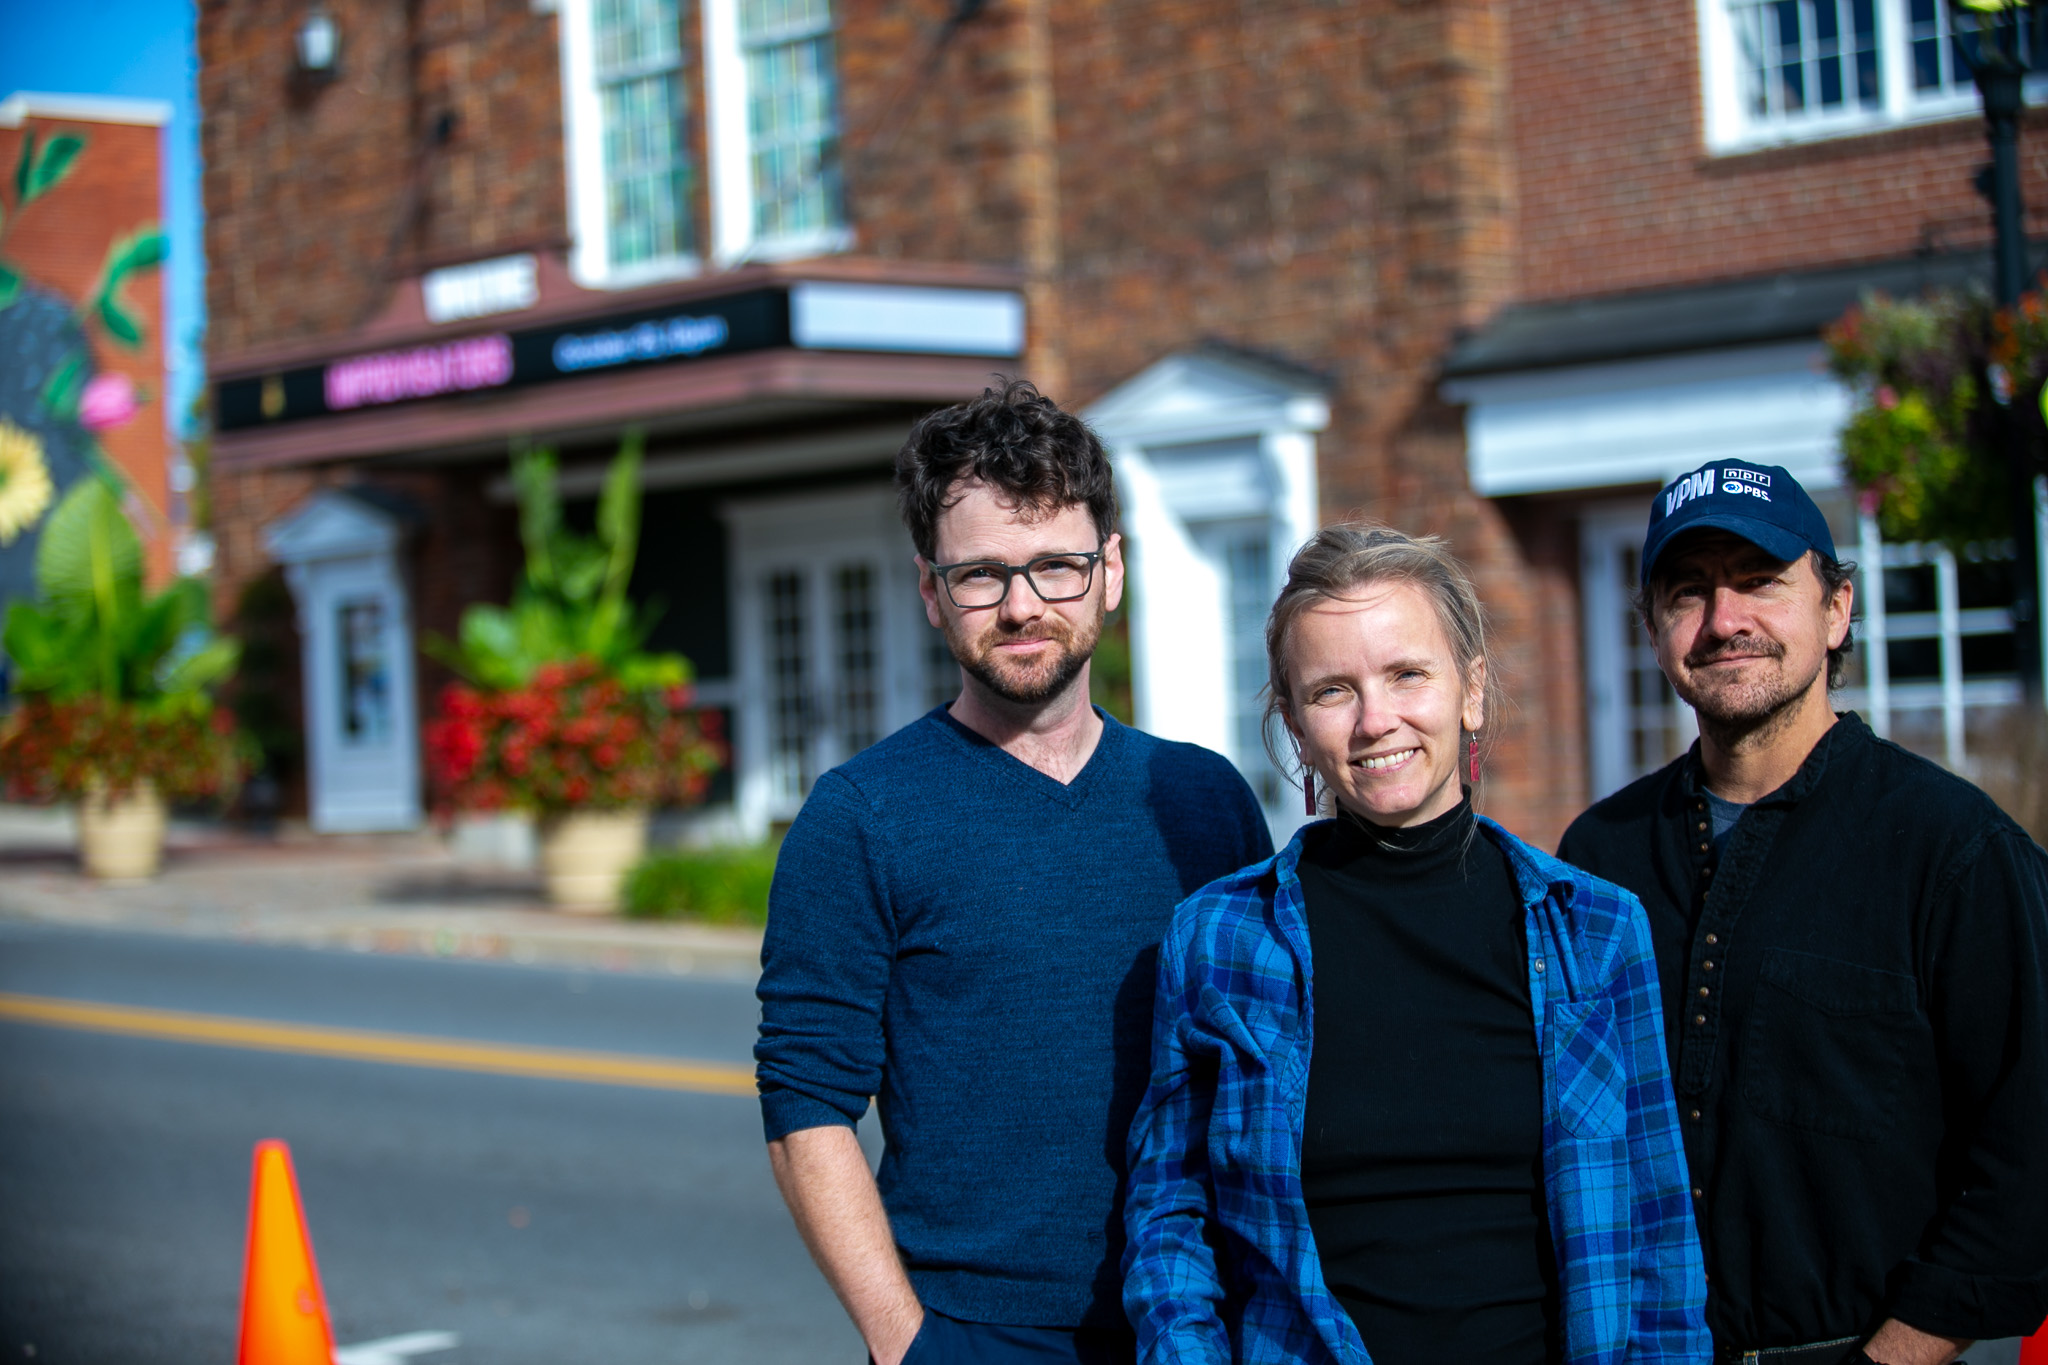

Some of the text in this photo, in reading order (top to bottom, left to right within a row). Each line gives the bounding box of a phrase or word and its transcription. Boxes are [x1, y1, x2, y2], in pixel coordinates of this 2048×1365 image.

[1725, 468, 1769, 485] npr
[1665, 469, 1715, 518] VPM
[1743, 485, 1771, 502] PBS
